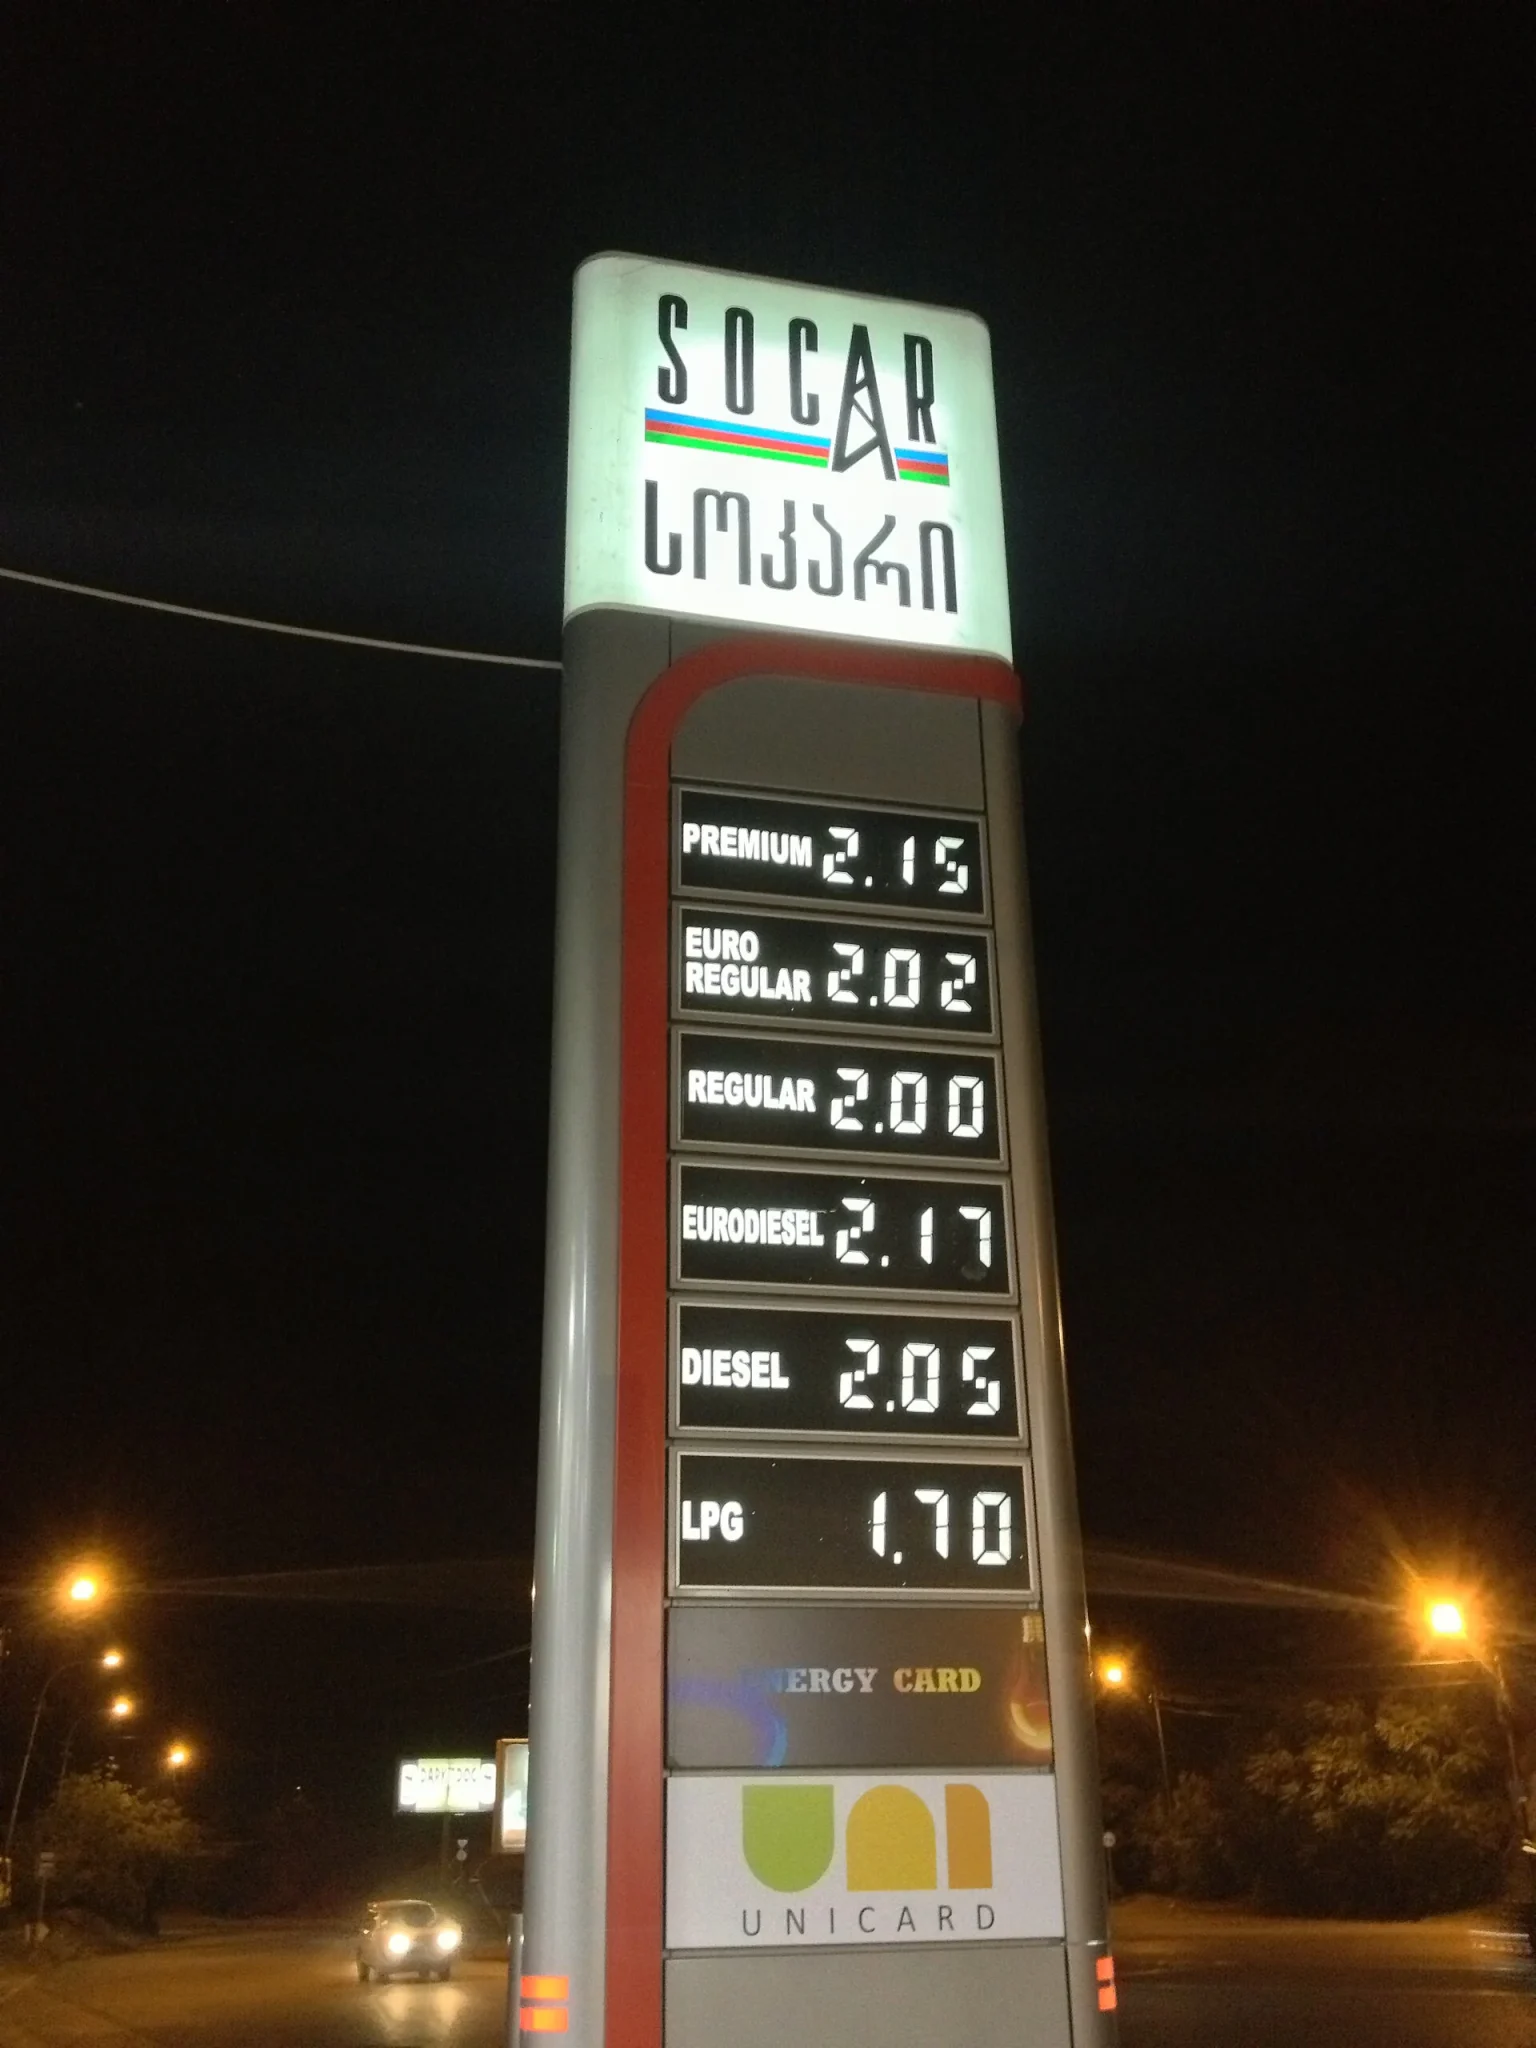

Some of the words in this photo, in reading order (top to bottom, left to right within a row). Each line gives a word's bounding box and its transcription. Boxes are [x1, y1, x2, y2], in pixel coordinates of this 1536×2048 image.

[658, 292, 937, 481] SOCAR
[683, 823, 812, 867] PREMIUM
[823, 826, 969, 894] 2.15
[686, 926, 759, 962] EURO
[686, 961, 812, 1002] REGULAR
[828, 942, 976, 1012] 2.02
[688, 1070, 816, 1112] REGULAR
[830, 1067, 984, 1138] 2.00
[682, 1205, 824, 1246] EURODIESEL
[836, 1198, 992, 1268] 2.17
[682, 1347, 789, 1389] DIESEL
[840, 1339, 1000, 1415] 2.05
[682, 1501, 743, 1541] LPG
[872, 1489, 1012, 1566] 1.70
[894, 1667, 981, 1693] CARD
[742, 1904, 995, 1936] UNICARD
